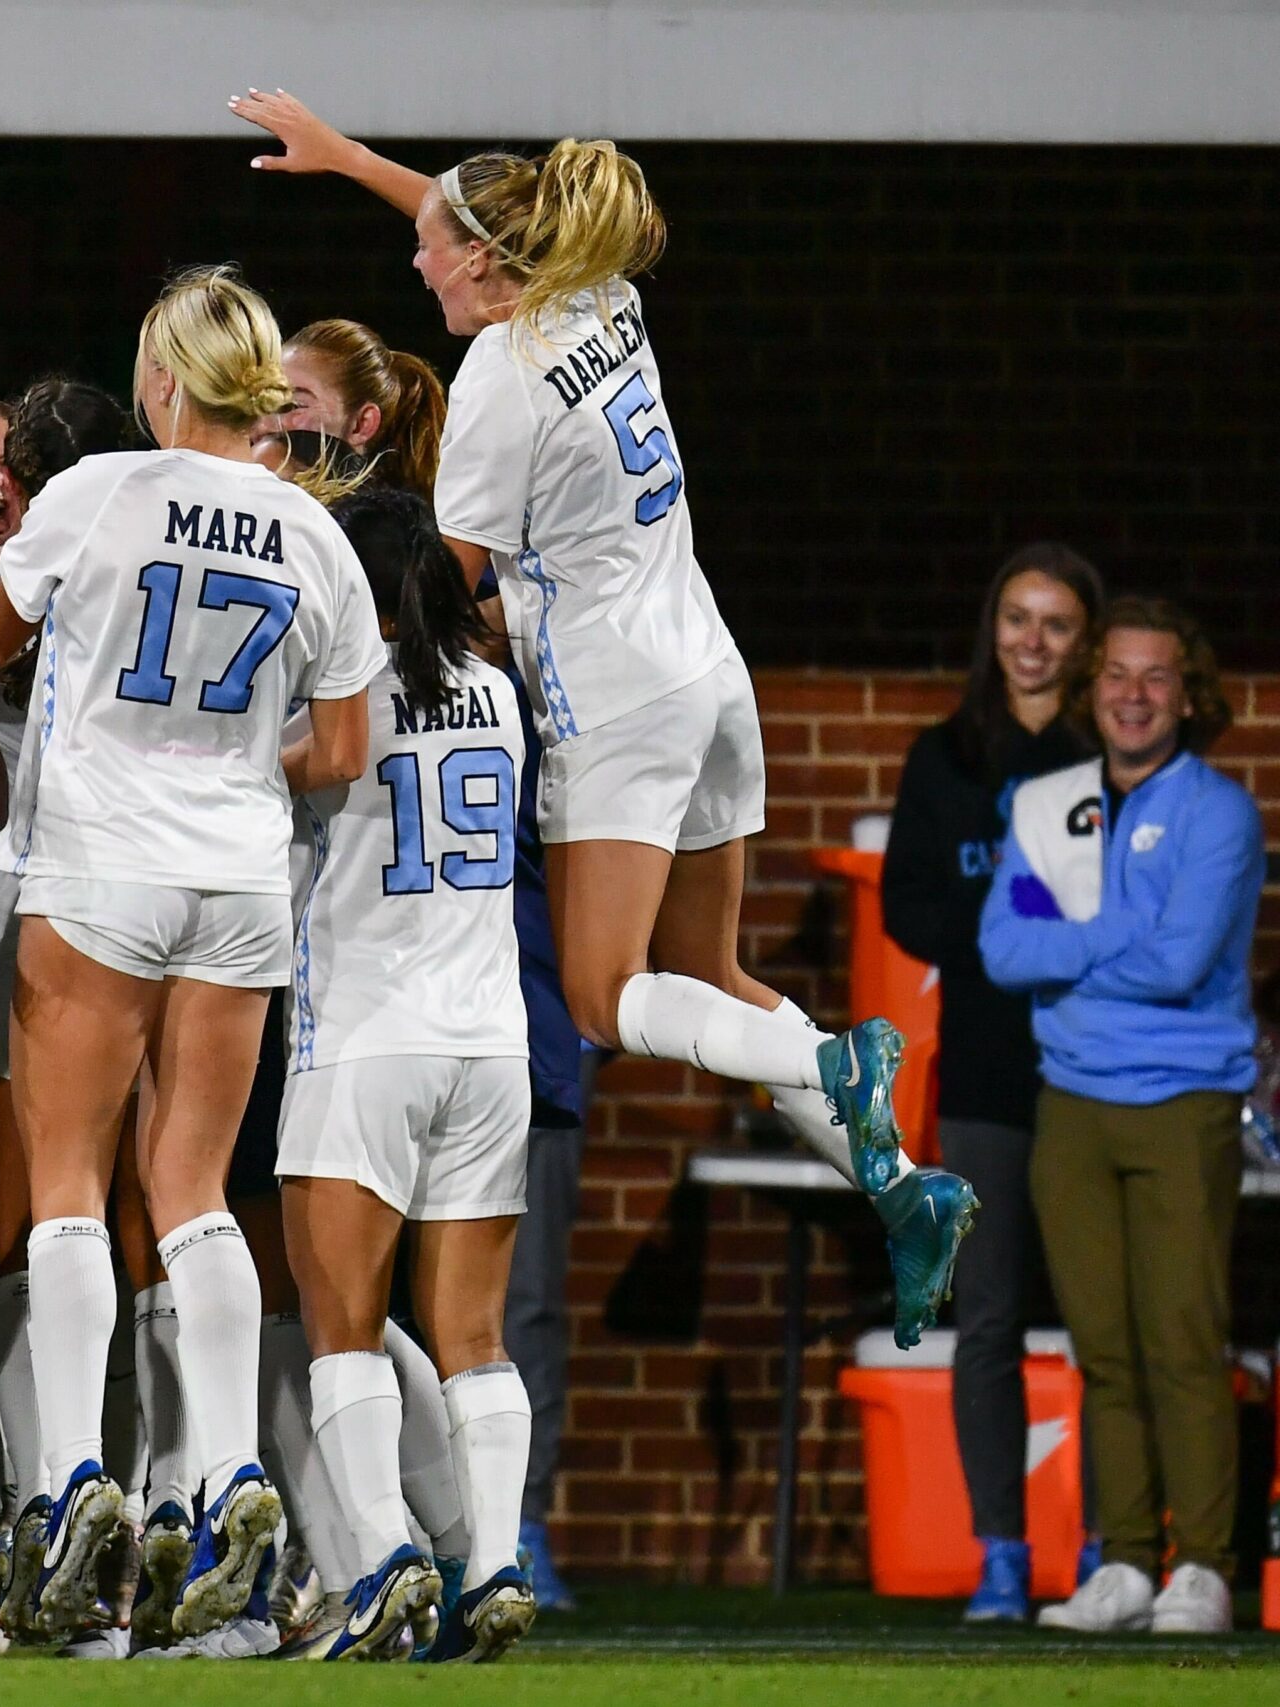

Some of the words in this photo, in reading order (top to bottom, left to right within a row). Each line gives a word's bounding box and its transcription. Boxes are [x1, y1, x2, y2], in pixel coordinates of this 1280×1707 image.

[601, 369, 682, 527] 5
[164, 500, 284, 564] MARA
[116, 560, 301, 714] 17
[391, 685, 500, 735] NAGAI
[376, 746, 516, 897] 19
